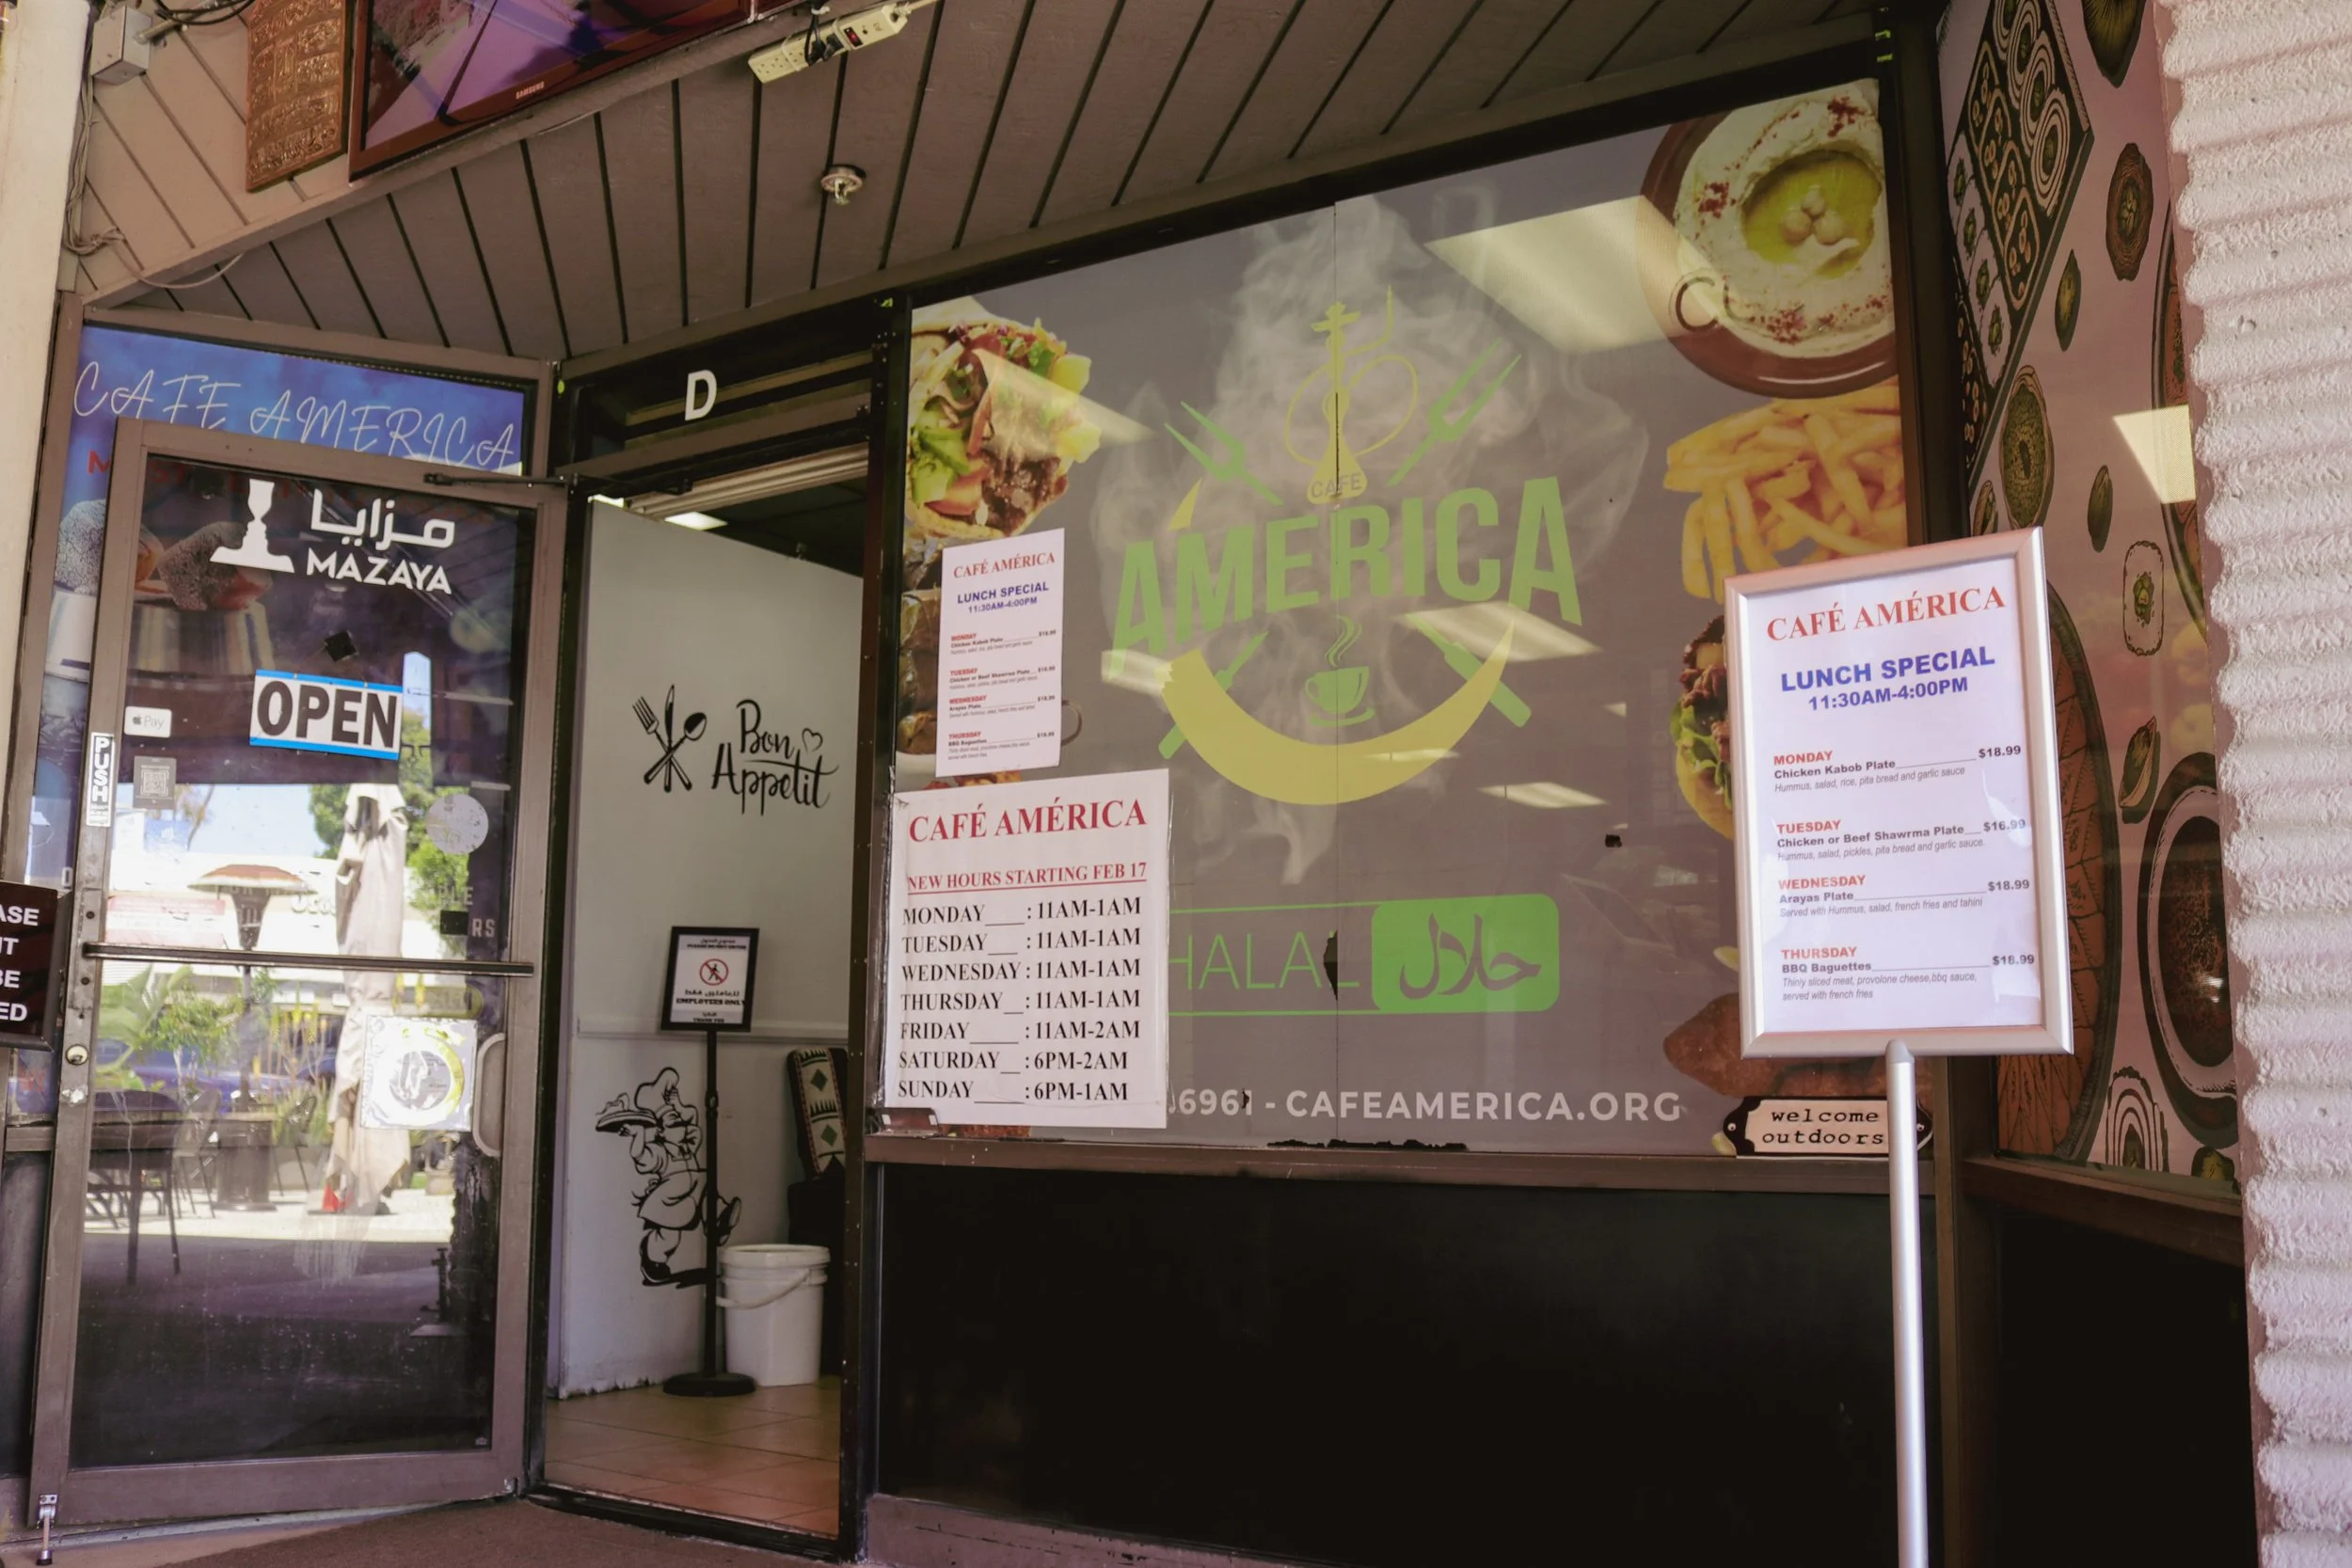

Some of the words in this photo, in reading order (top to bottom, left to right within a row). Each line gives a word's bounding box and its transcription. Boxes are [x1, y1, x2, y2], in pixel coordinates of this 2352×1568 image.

[685, 370, 717, 421] D
[72, 361, 241, 431] CAFE
[249, 390, 516, 468] AMERICA
[1311, 472, 1362, 498] CAFE
[307, 548, 453, 595] MAZAYA
[953, 559, 989, 578] CAFÉ
[992, 552, 1055, 573] AMÉRICA
[1108, 476, 1581, 680] AMERICA
[958, 590, 996, 604] LUNCH
[1000, 581, 1049, 597] SPECIAL
[969, 596, 1037, 613] 11:30AM-4:00PM
[1767, 602, 1846, 641] CAFÉ
[1853, 586, 2006, 629] AMÉRICA
[1781, 663, 1871, 691] LUNCH
[1882, 646, 1995, 679] SPECIAL
[1809, 677, 1968, 710] 11:30AM-4:00PM
[144, 715, 165, 729] Pay
[257, 679, 398, 748] OPEN
[736, 699, 794, 759] Bon
[91, 736, 110, 802] PUSH
[1773, 751, 1833, 766] MONDAY
[1774, 767, 1821, 779] Chicken
[1824, 764, 1862, 775] Kabob
[1979, 745, 2021, 759] $18.99
[710, 742, 839, 816] Appetit
[1775, 782, 1812, 793] Hummus,
[1815, 779, 1838, 789] salad,
[1840, 778, 1857, 787] rice,
[1859, 775, 1874, 787] pita
[1876, 772, 1899, 784] bread
[1900, 770, 1915, 782] and
[1917, 768, 1939, 782] garlic
[1941, 767, 1965, 776] sauce
[910, 803, 987, 842] CAFÉ
[994, 797, 1148, 836] AMÉRICA
[1777, 819, 1841, 834] TUESDAY
[1777, 836, 1824, 848] Chicken
[1828, 835, 1840, 845] or
[1843, 832, 1870, 844] Beef
[1874, 830, 1931, 841] Shawrma
[1983, 818, 2026, 832] $16.99
[1818, 848, 1840, 860] salad,
[1843, 846, 1872, 858] pickles,
[1875, 844, 1891, 857] pita
[1892, 841, 1915, 852] bread
[1917, 839, 1932, 851] and
[1934, 837, 1957, 851] garlic
[908, 873, 941, 892] NEW
[946, 870, 1002, 889] HOURS
[1006, 864, 1088, 887] STARTING
[1092, 863, 1125, 880] FEB
[1130, 863, 1147, 879] 17
[1779, 875, 1866, 890] WEDNESDAY
[1779, 894, 1820, 905] Arayas
[1988, 879, 2029, 892] $18.99
[1780, 906, 1808, 918] Served
[1810, 905, 1826, 915] with
[1828, 904, 1866, 915] Hummus,
[1868, 902, 1893, 913] salad,
[1895, 899, 1920, 911] french
[1922, 898, 1940, 911] fries
[1942, 898, 1959, 910] and
[1960, 896, 1983, 908] tahini
[1399, 911, 1543, 1000] حلال
[1781, 946, 1857, 960] THURSDAY
[1782, 962, 1807, 974] BBQ
[1993, 954, 2035, 966] $18.99
[0, 970, 21, 989] E
[901, 961, 1022, 982] WEDNESDAY
[1783, 976, 1806, 989] Thinly
[1808, 975, 1832, 987] sliced
[1833, 975, 1854, 986] meat,
[1857, 974, 1898, 987] provolone
[1783, 990, 1809, 1001] served
[1811, 989, 1827, 1000] with
[1828, 989, 1853, 1000] french
[1855, 989, 1874, 999] fries
[1286, 1089, 1681, 1122] CAFEAMERICA.ORG
[1771, 1109, 1880, 1123] welcome
[1762, 1130, 1884, 1145] outdoors
